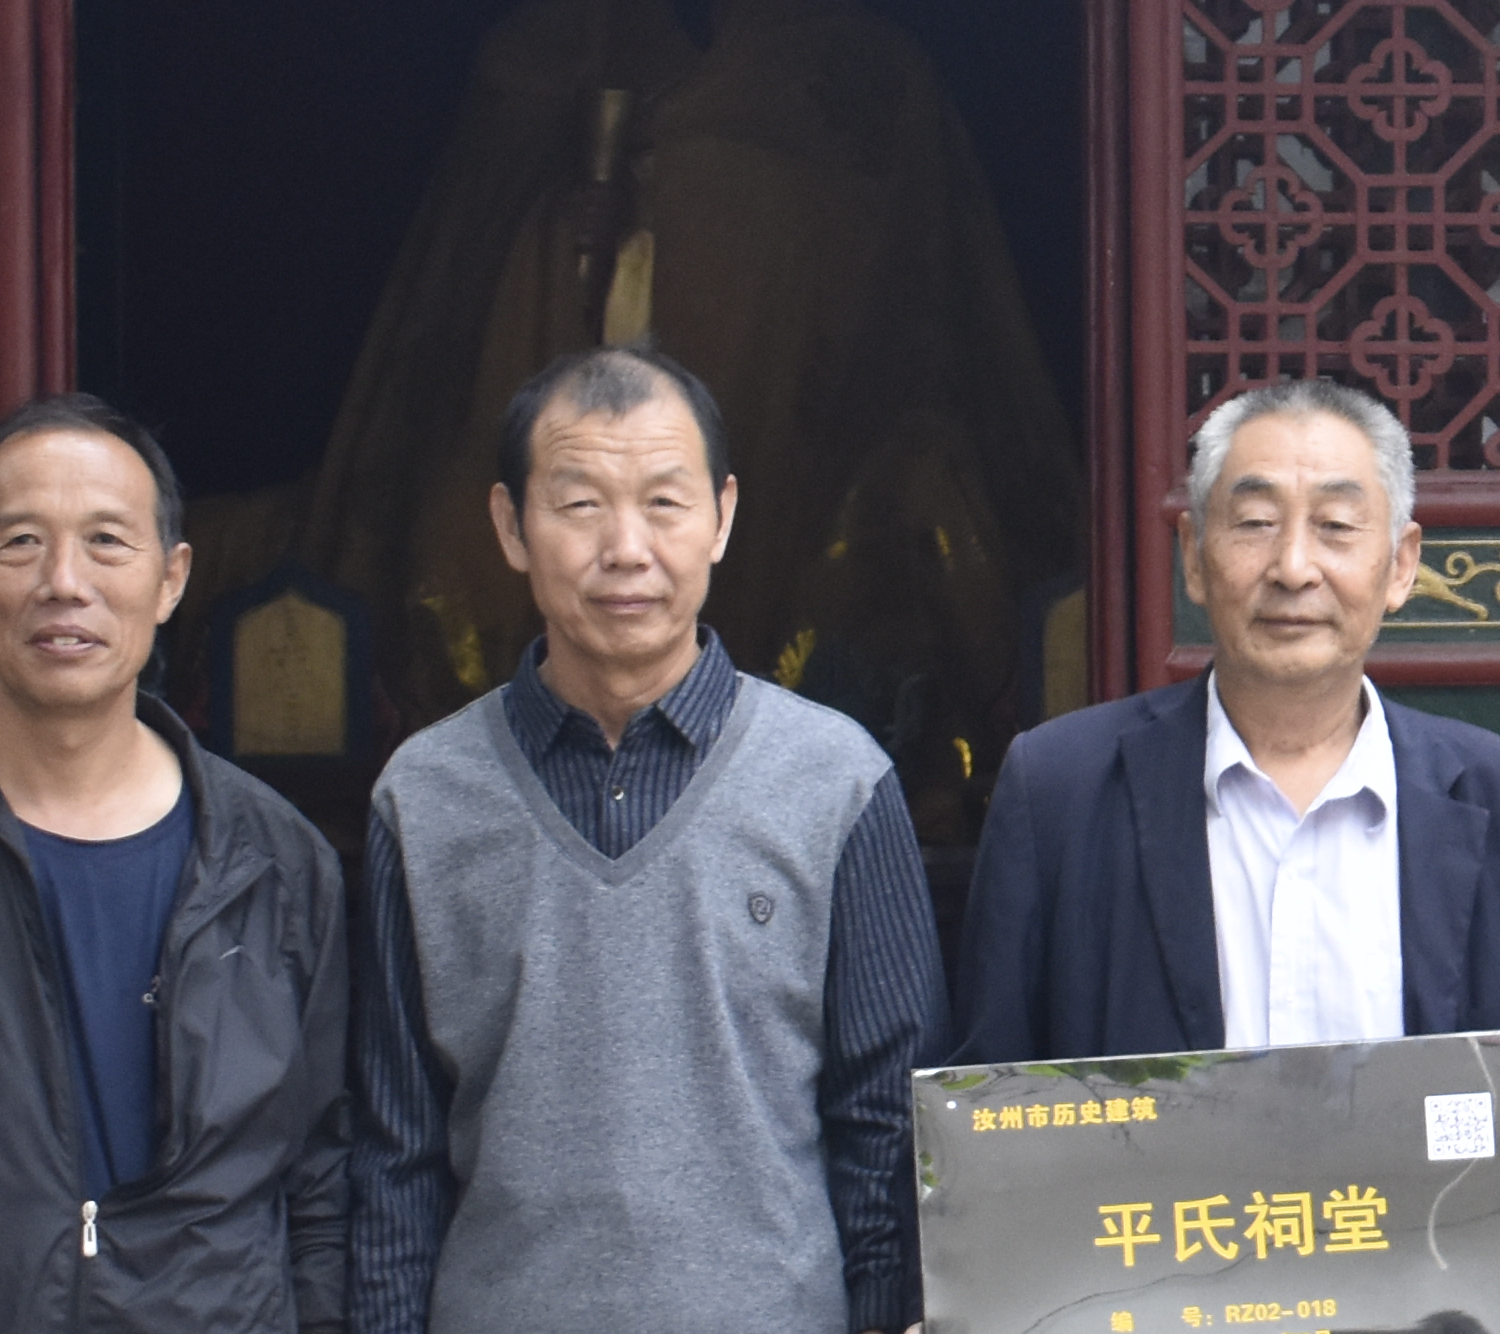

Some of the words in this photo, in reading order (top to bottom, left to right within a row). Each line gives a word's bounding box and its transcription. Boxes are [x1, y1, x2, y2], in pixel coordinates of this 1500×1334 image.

[972, 1095, 1158, 1132] 汝州市历史建筑
[1093, 1184, 1390, 1267] 平氏祠堂
